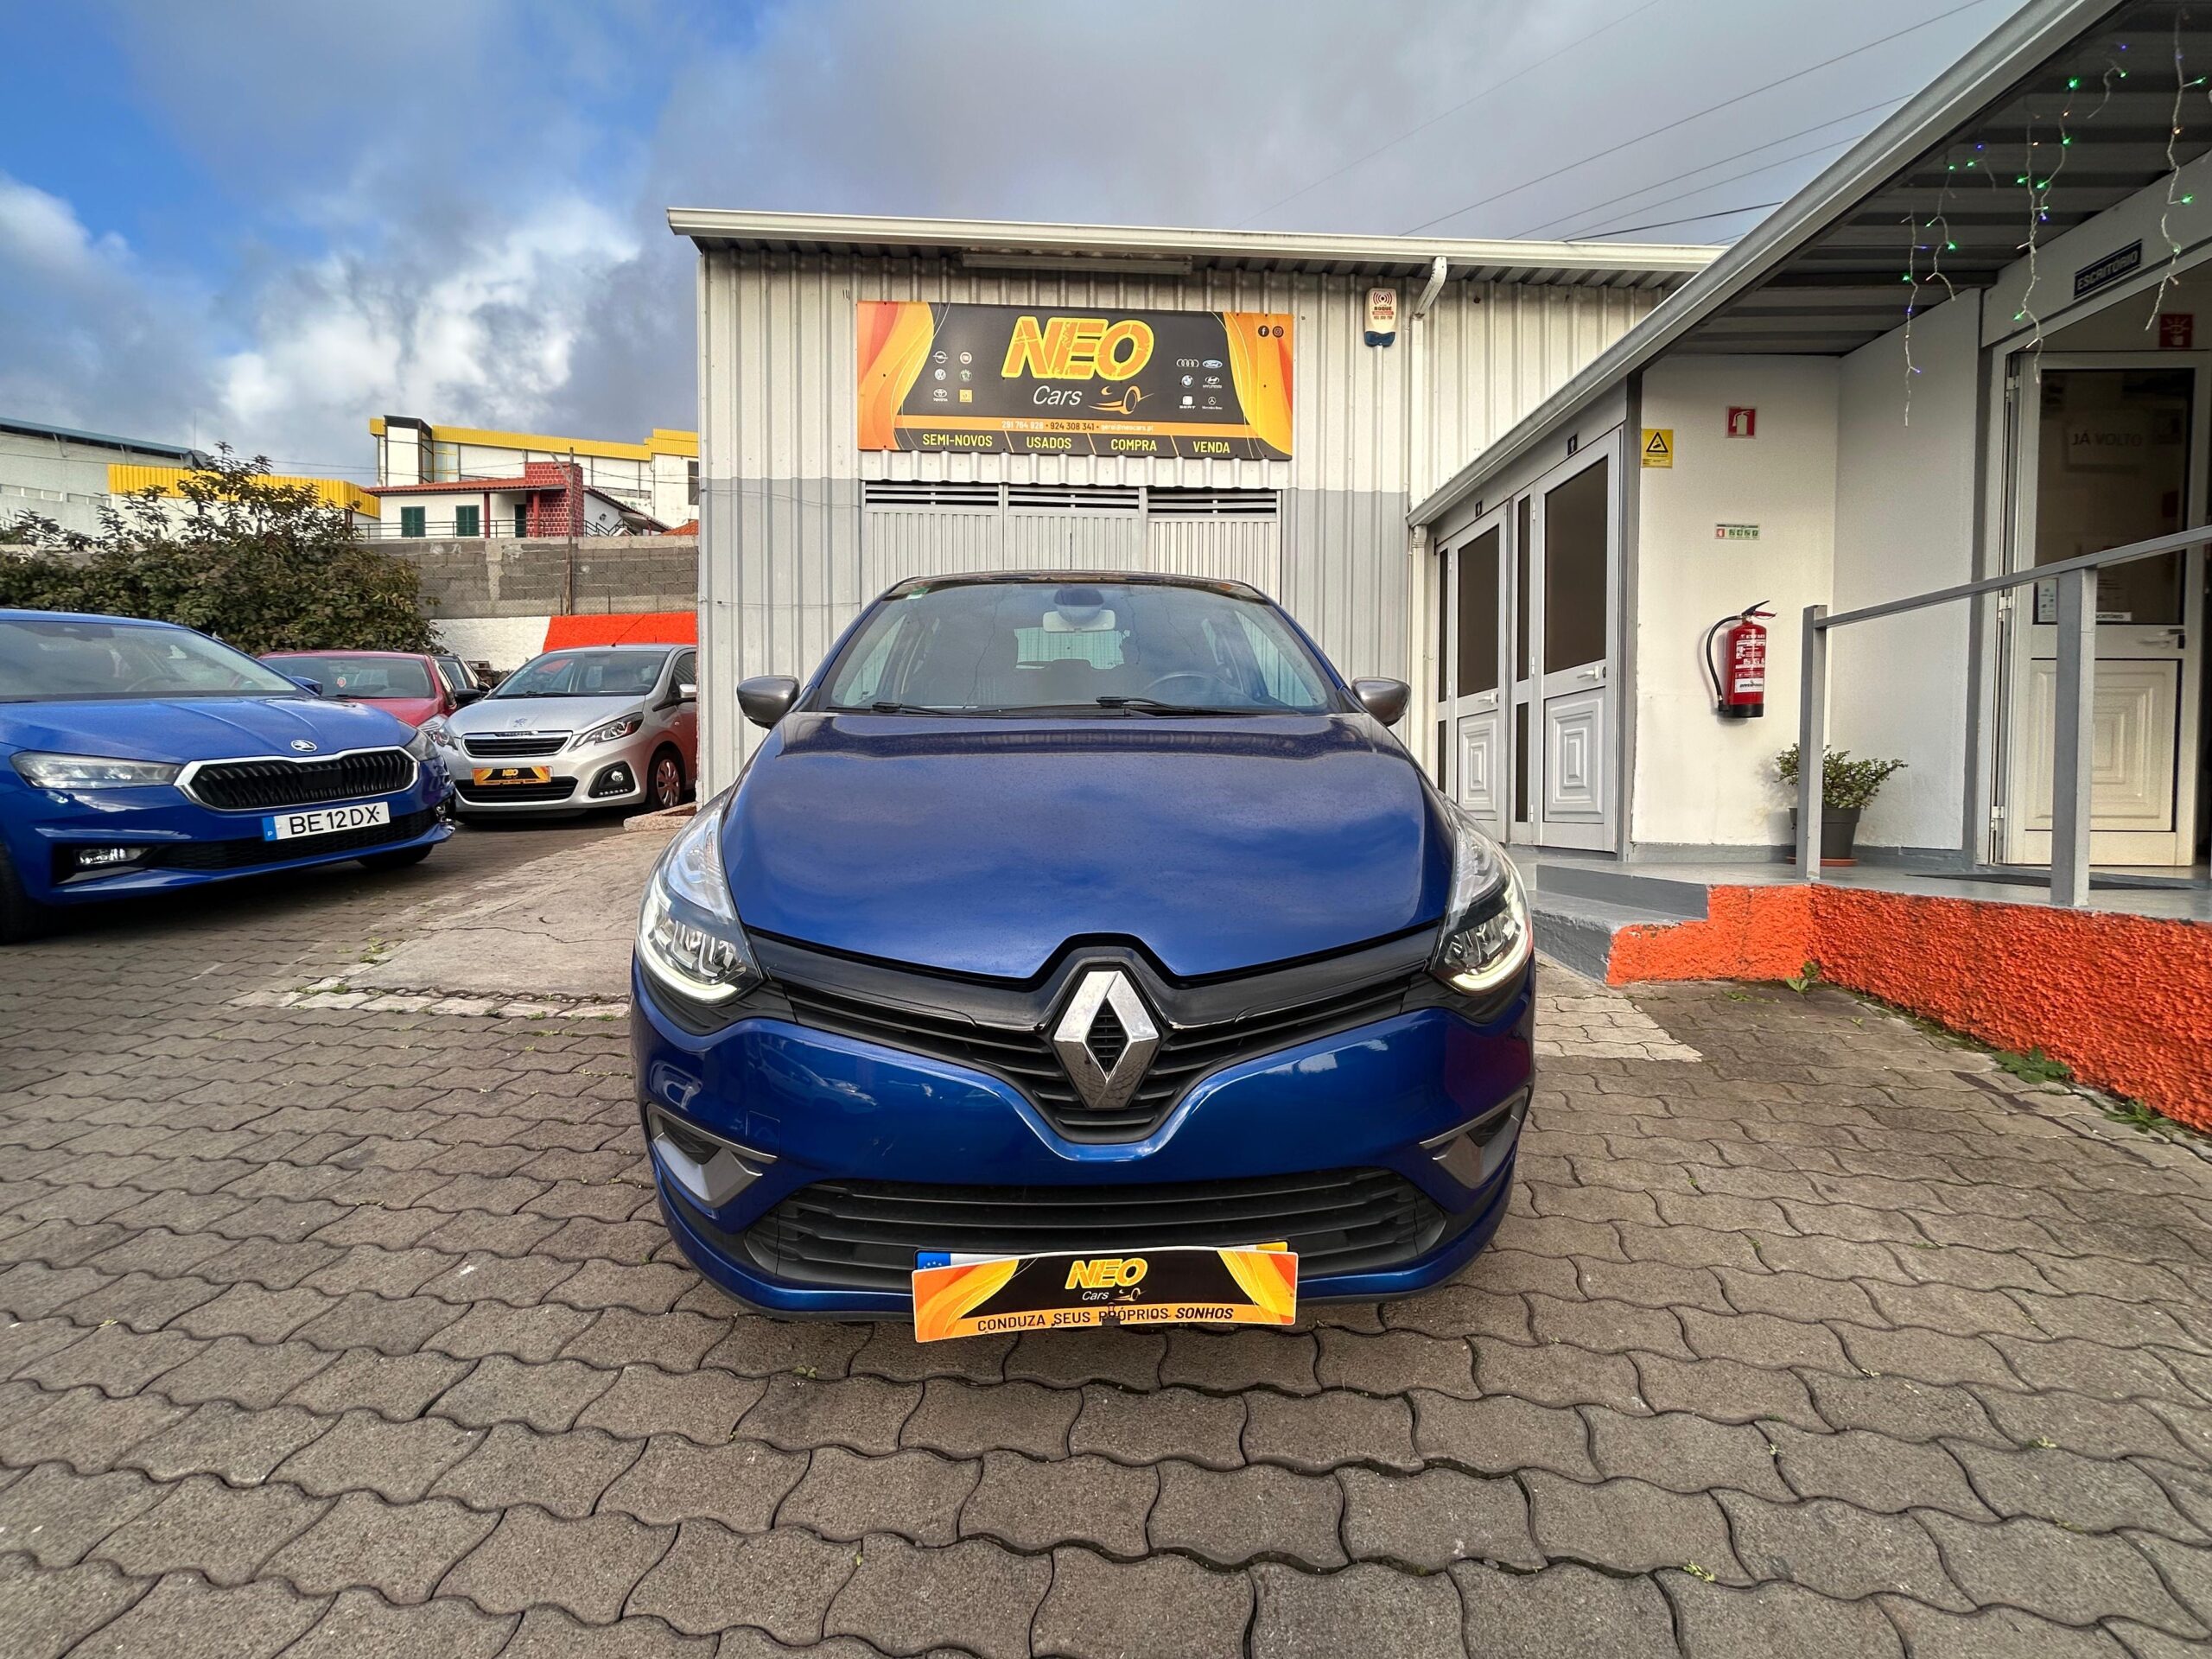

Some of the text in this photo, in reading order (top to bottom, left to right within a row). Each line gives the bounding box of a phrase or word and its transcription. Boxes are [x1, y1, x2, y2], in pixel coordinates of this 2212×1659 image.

[1001, 316, 1154, 381] NEO
[1033, 385, 1083, 405] Cars
[1050, 422, 1064, 430] 924
[1066, 423, 1080, 431] 308
[1082, 423, 1095, 431] 341
[922, 434, 1230, 454] SEMI-NOVOS USADOS COMPRA VENDA
[289, 805, 380, 835] BE 12 DX
[1065, 1257, 1148, 1289] NEO
[1082, 1291, 1109, 1300] Cars
[977, 1316, 1046, 1332] CONDUZA
[1053, 1311, 1091, 1325] SEUS
[1175, 1306, 1234, 1319] SONHOS
